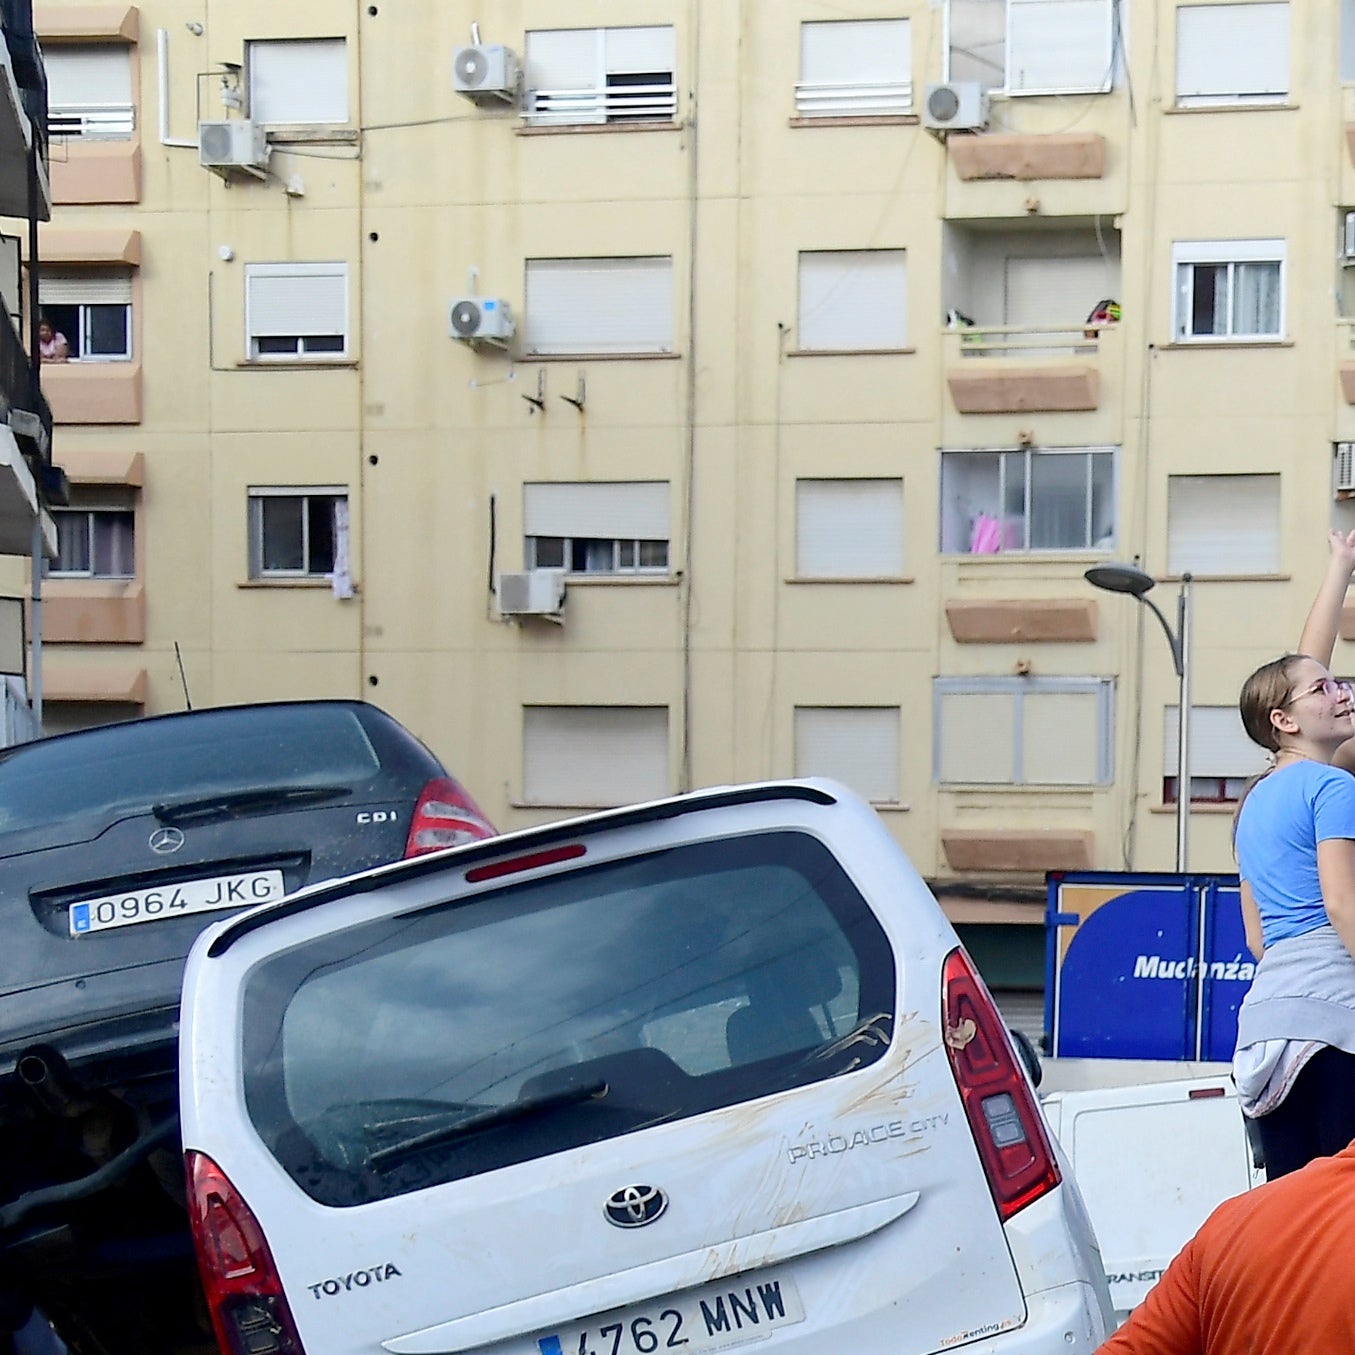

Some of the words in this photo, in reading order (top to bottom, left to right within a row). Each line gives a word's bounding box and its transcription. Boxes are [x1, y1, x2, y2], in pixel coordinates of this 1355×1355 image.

[356, 811, 397, 824] CDI
[96, 888, 188, 924] 0964
[205, 877, 271, 905] JKG
[787, 1120, 906, 1165] PROACE
[909, 1113, 949, 1134] CITY
[307, 1262, 403, 1300] TOYOTA
[1105, 1269, 1164, 1284] RANSIT
[699, 1281, 786, 1337] MNW
